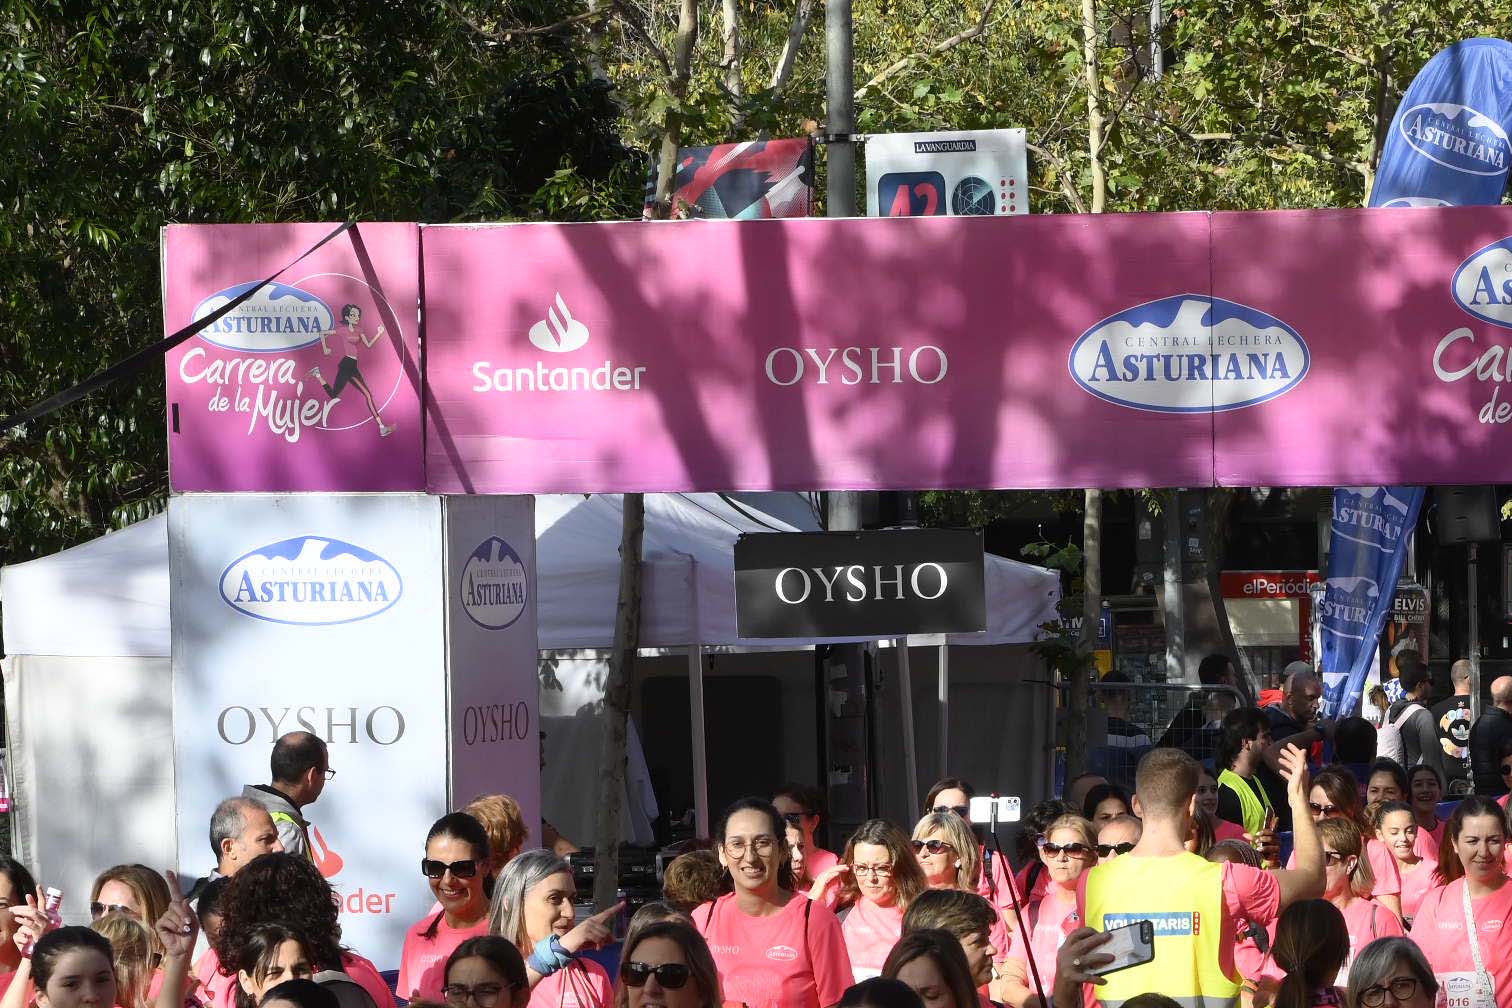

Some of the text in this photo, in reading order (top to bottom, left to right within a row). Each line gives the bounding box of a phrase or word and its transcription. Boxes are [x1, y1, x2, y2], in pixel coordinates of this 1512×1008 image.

[1407, 113, 1504, 168] ASTURIANA
[1088, 339, 1292, 382] ASTURIANA
[1125, 334, 1283, 347] CENTRAL LECHERA
[179, 346, 296, 385] Carrera
[472, 360, 646, 394] Santander
[765, 345, 948, 386] OYSHO
[208, 381, 341, 443] de la Mujer
[1479, 383, 1512, 425] de
[234, 570, 389, 604] ASTURIANA
[466, 571, 524, 607] ASTURIANA
[775, 562, 949, 604] OYSHO
[1395, 598, 1425, 610] ELVIS
[217, 705, 406, 747] OYSHO
[463, 701, 530, 747] OYSHO
[1448, 997, 1470, 1007] 016
